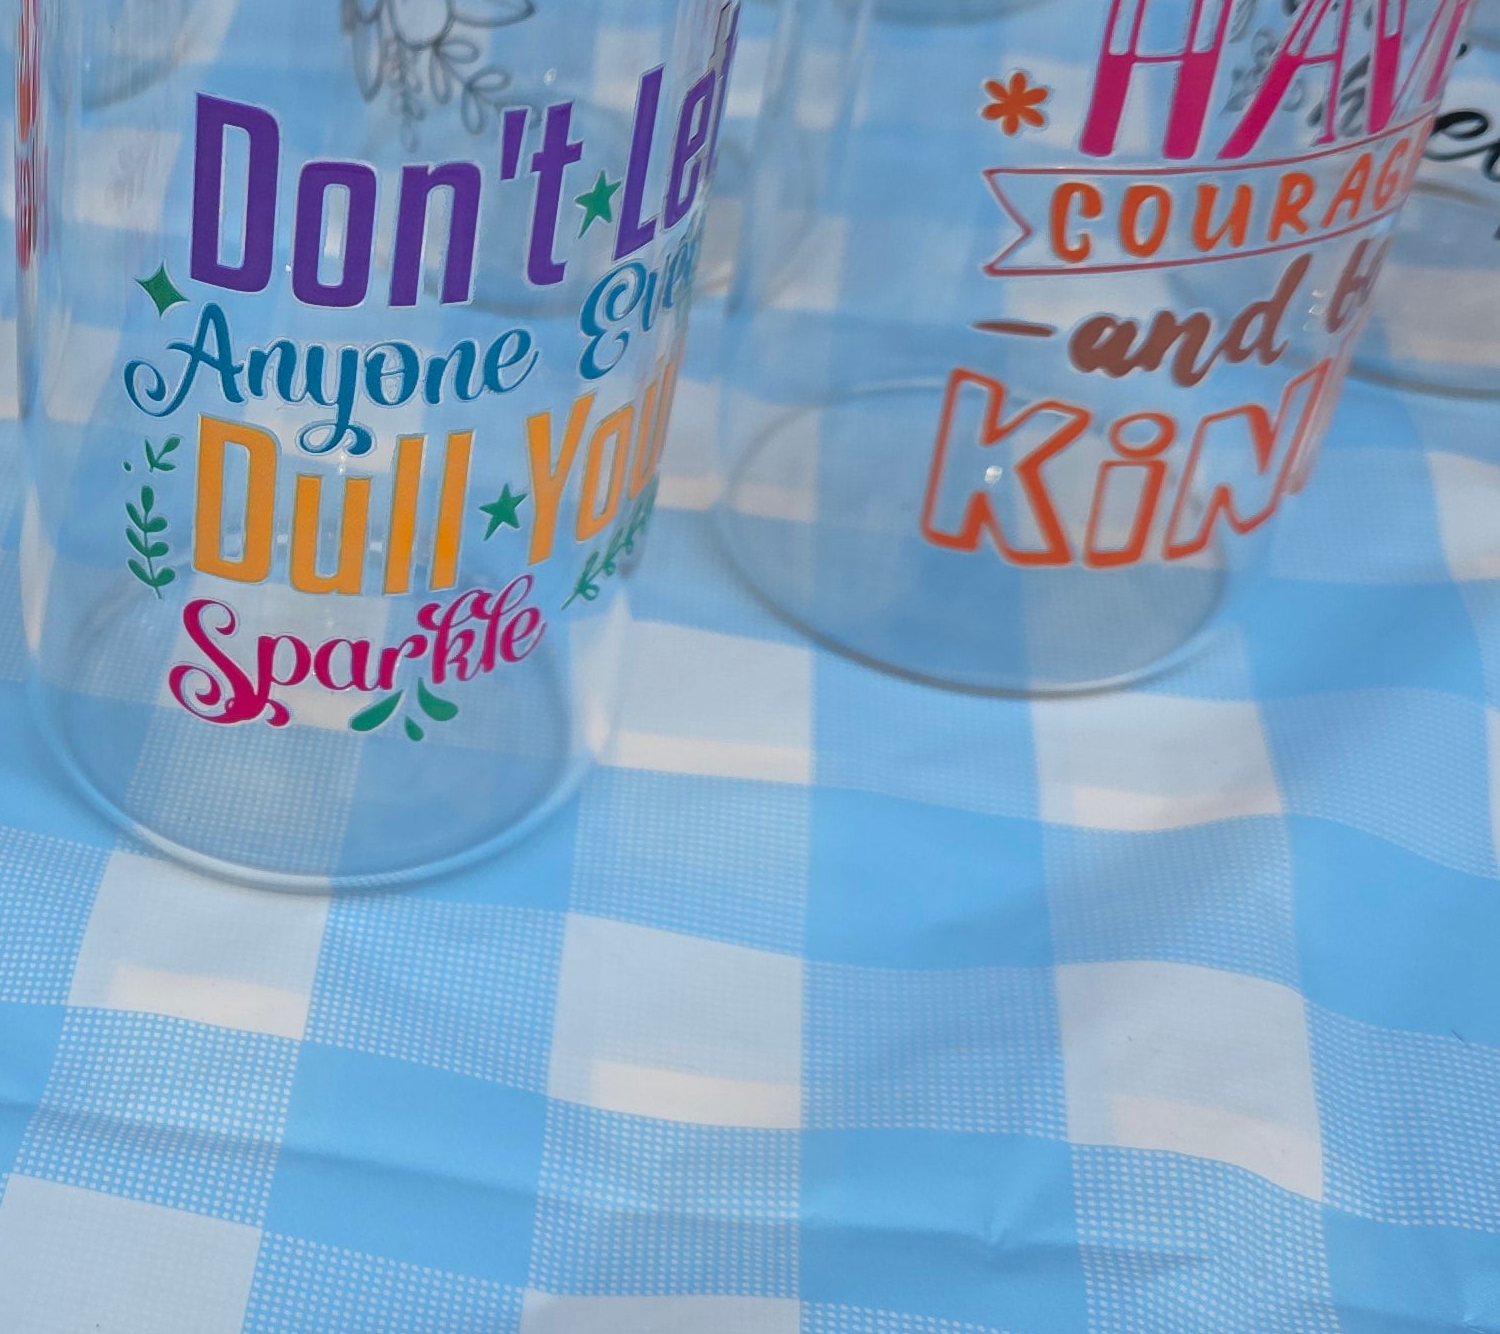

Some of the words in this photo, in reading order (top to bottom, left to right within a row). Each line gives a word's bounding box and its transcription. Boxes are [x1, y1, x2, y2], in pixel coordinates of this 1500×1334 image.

[189, 91, 583, 308] Don't
[123, 302, 540, 456] Anyone
[192, 413, 474, 596] Dull
[169, 573, 547, 727] Sparkle
